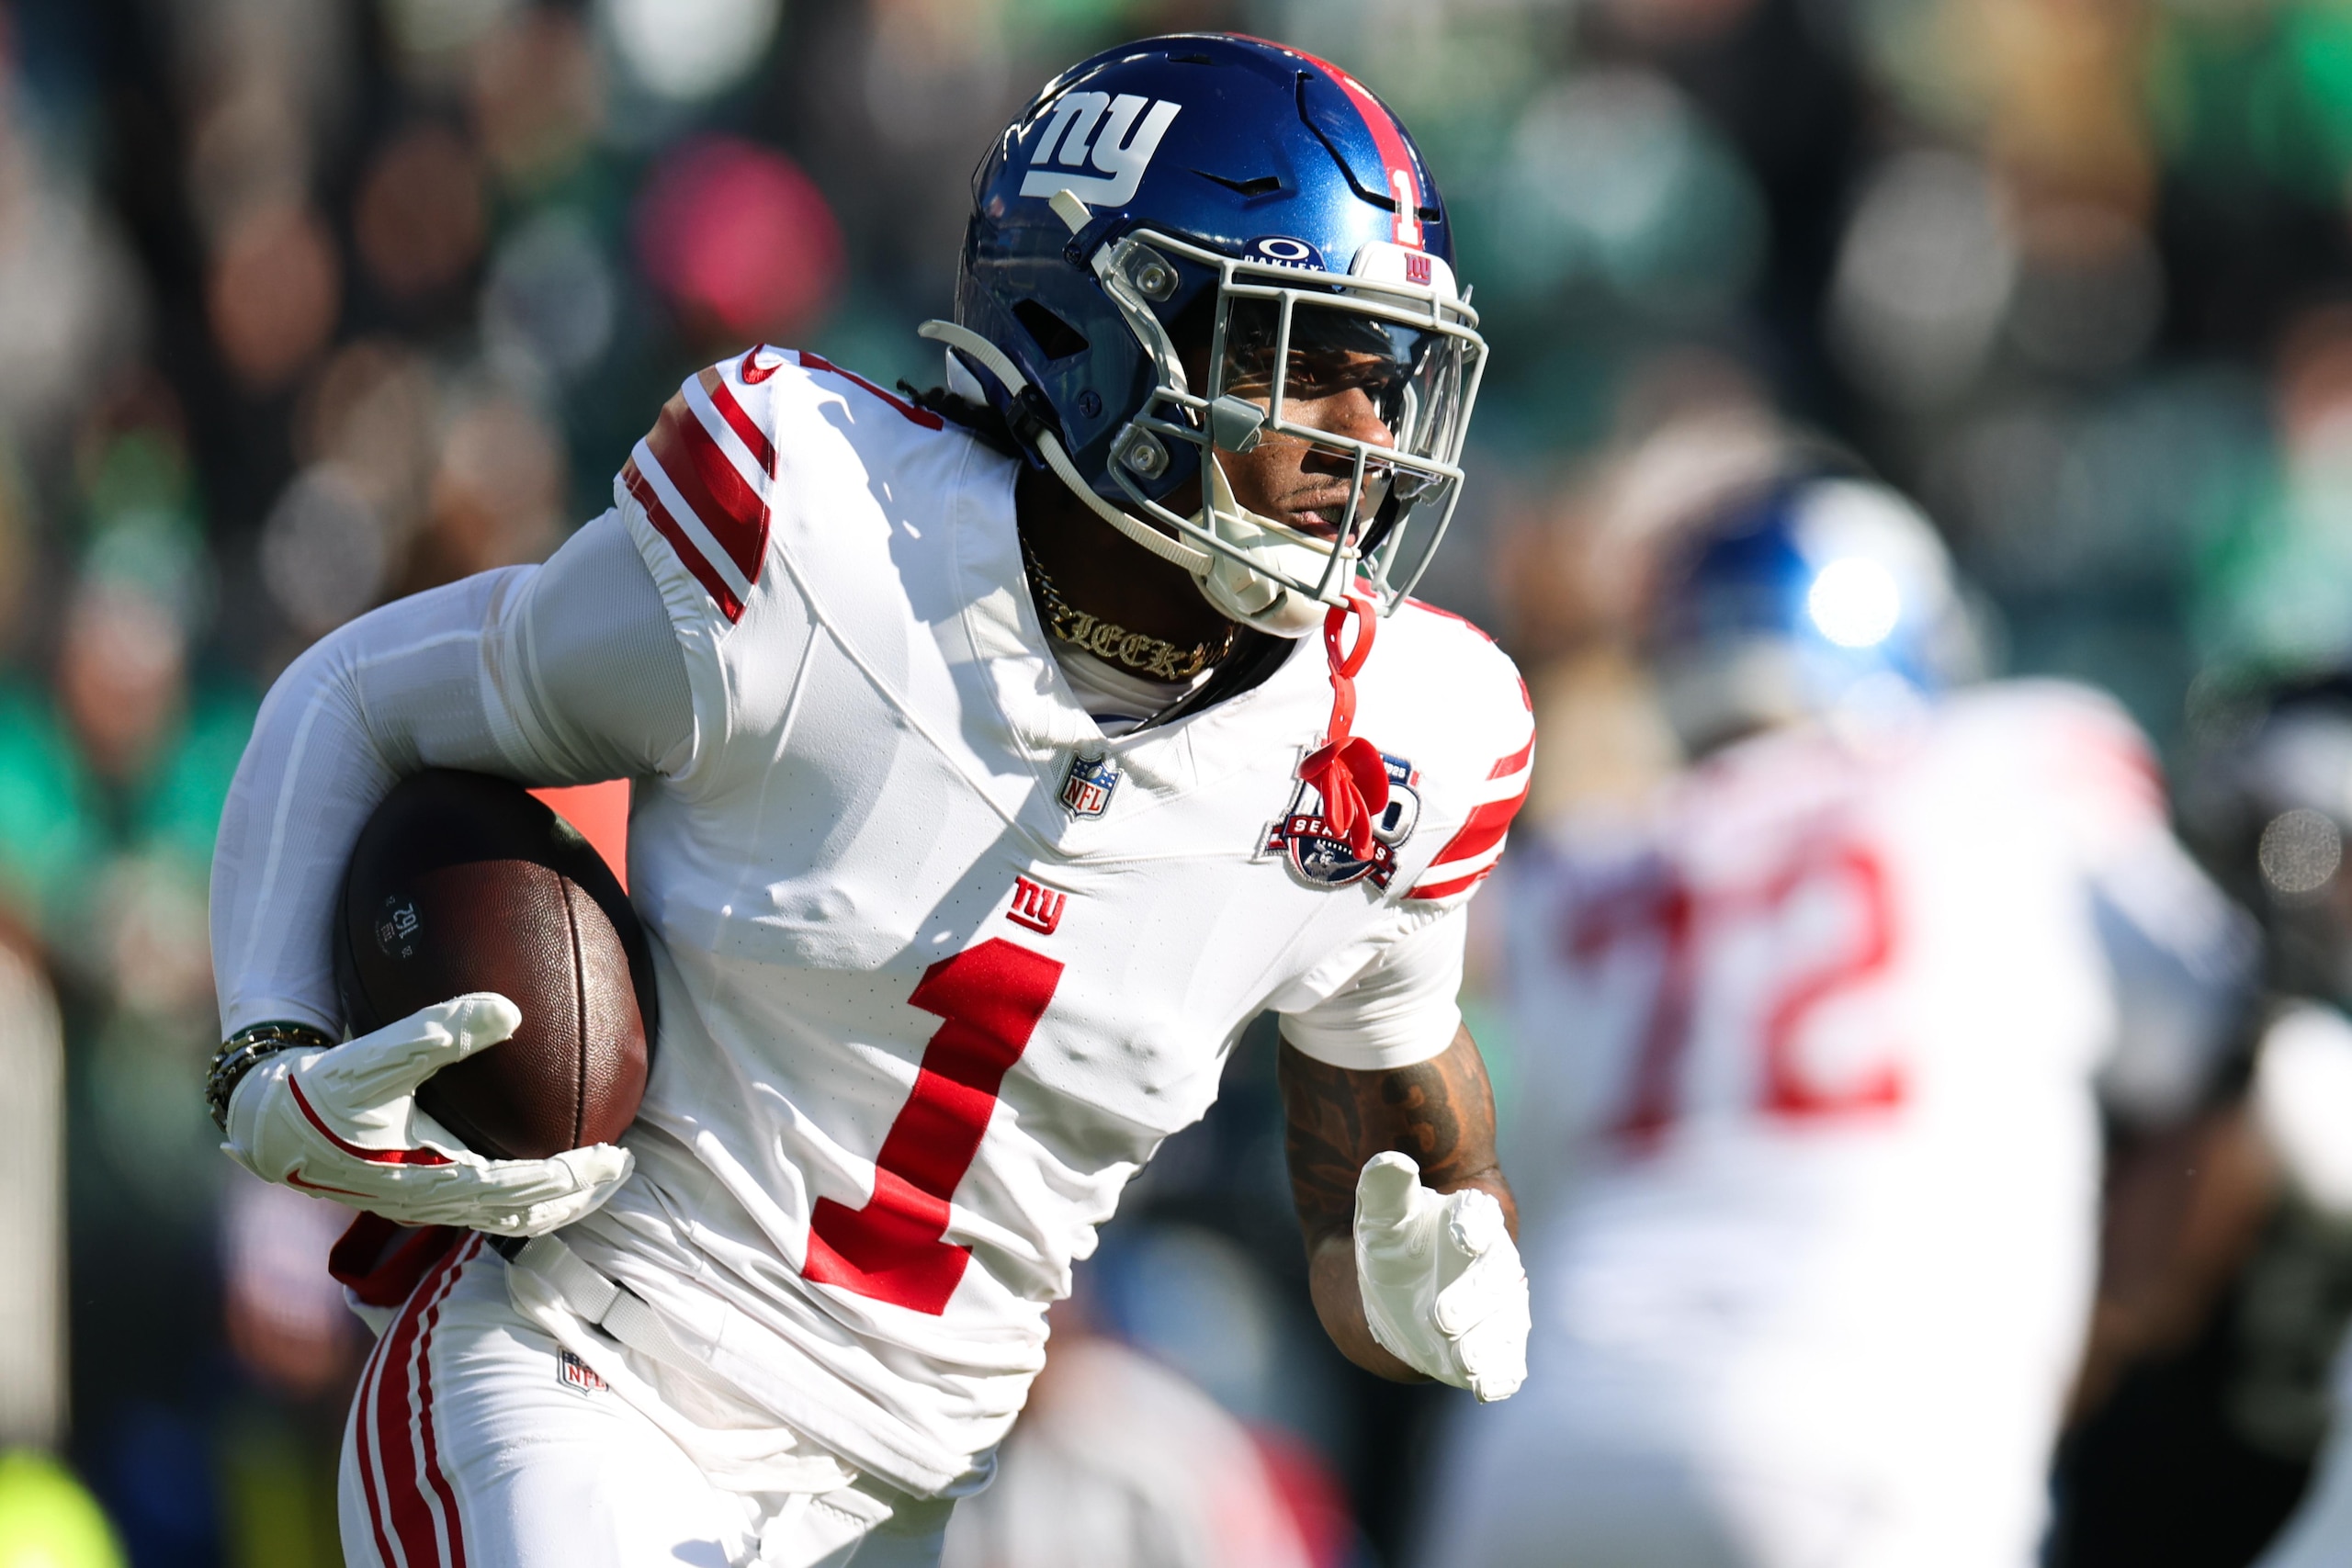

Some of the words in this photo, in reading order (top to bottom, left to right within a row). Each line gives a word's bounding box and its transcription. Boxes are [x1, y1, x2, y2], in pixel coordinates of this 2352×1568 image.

[1392, 169, 1419, 246] 1
[1064, 778, 1102, 812] NFL
[1560, 838, 1909, 1154] 72
[801, 936, 1066, 1316] 1
[567, 1364, 605, 1388] NFL
